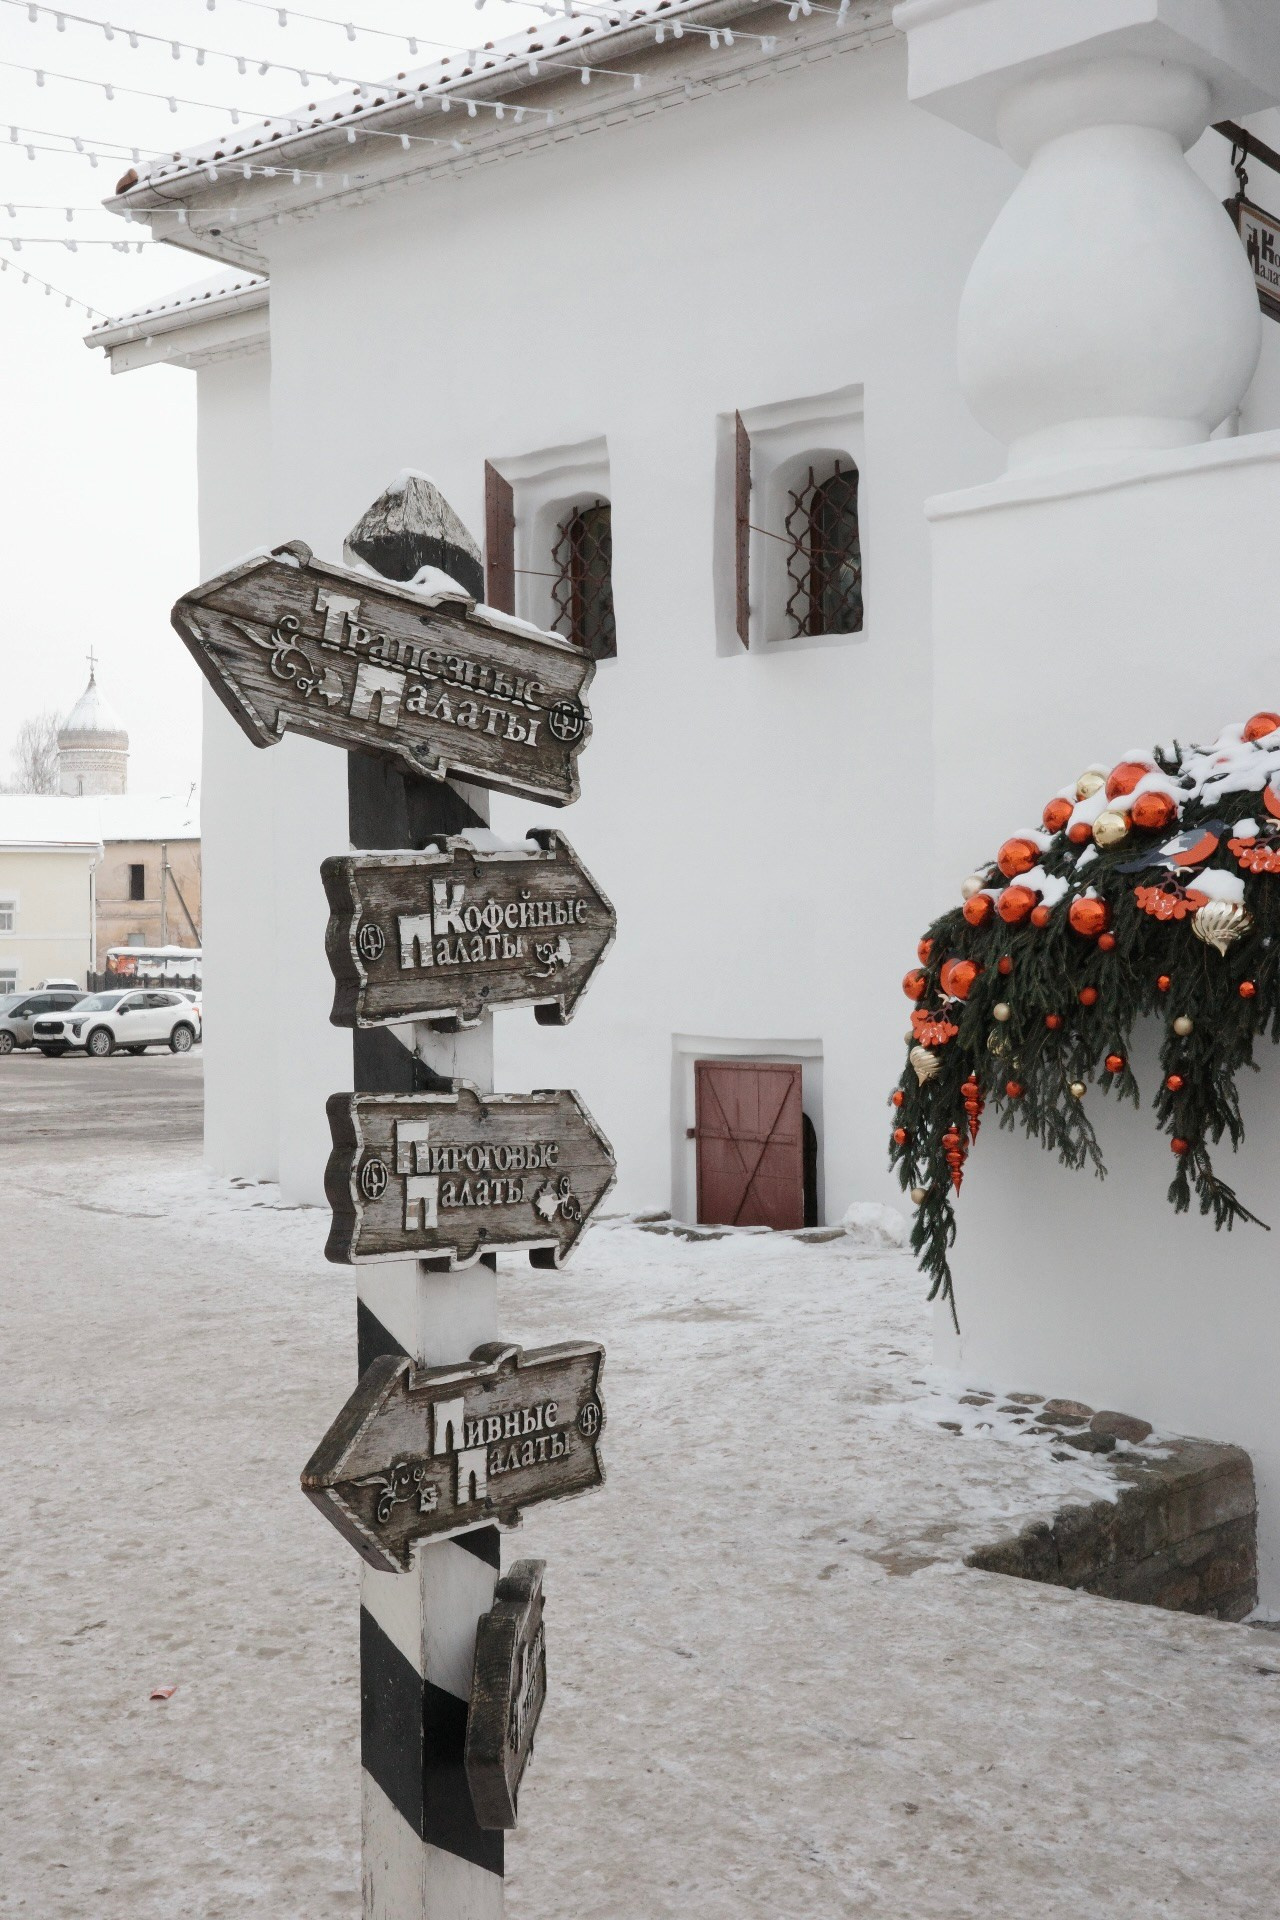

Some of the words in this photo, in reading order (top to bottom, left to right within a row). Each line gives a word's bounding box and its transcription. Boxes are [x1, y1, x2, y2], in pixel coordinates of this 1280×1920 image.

[314, 587, 546, 711] Трапезные
[349, 662, 542, 747] Палаты
[432, 878, 588, 935] Кофейные
[398, 913, 525, 969] Палаты
[396, 1118, 559, 1174] Пироговые
[405, 1175, 525, 1231] Палаты
[433, 1397, 558, 1455] Пивные
[457, 1432, 573, 1505] Палаты
